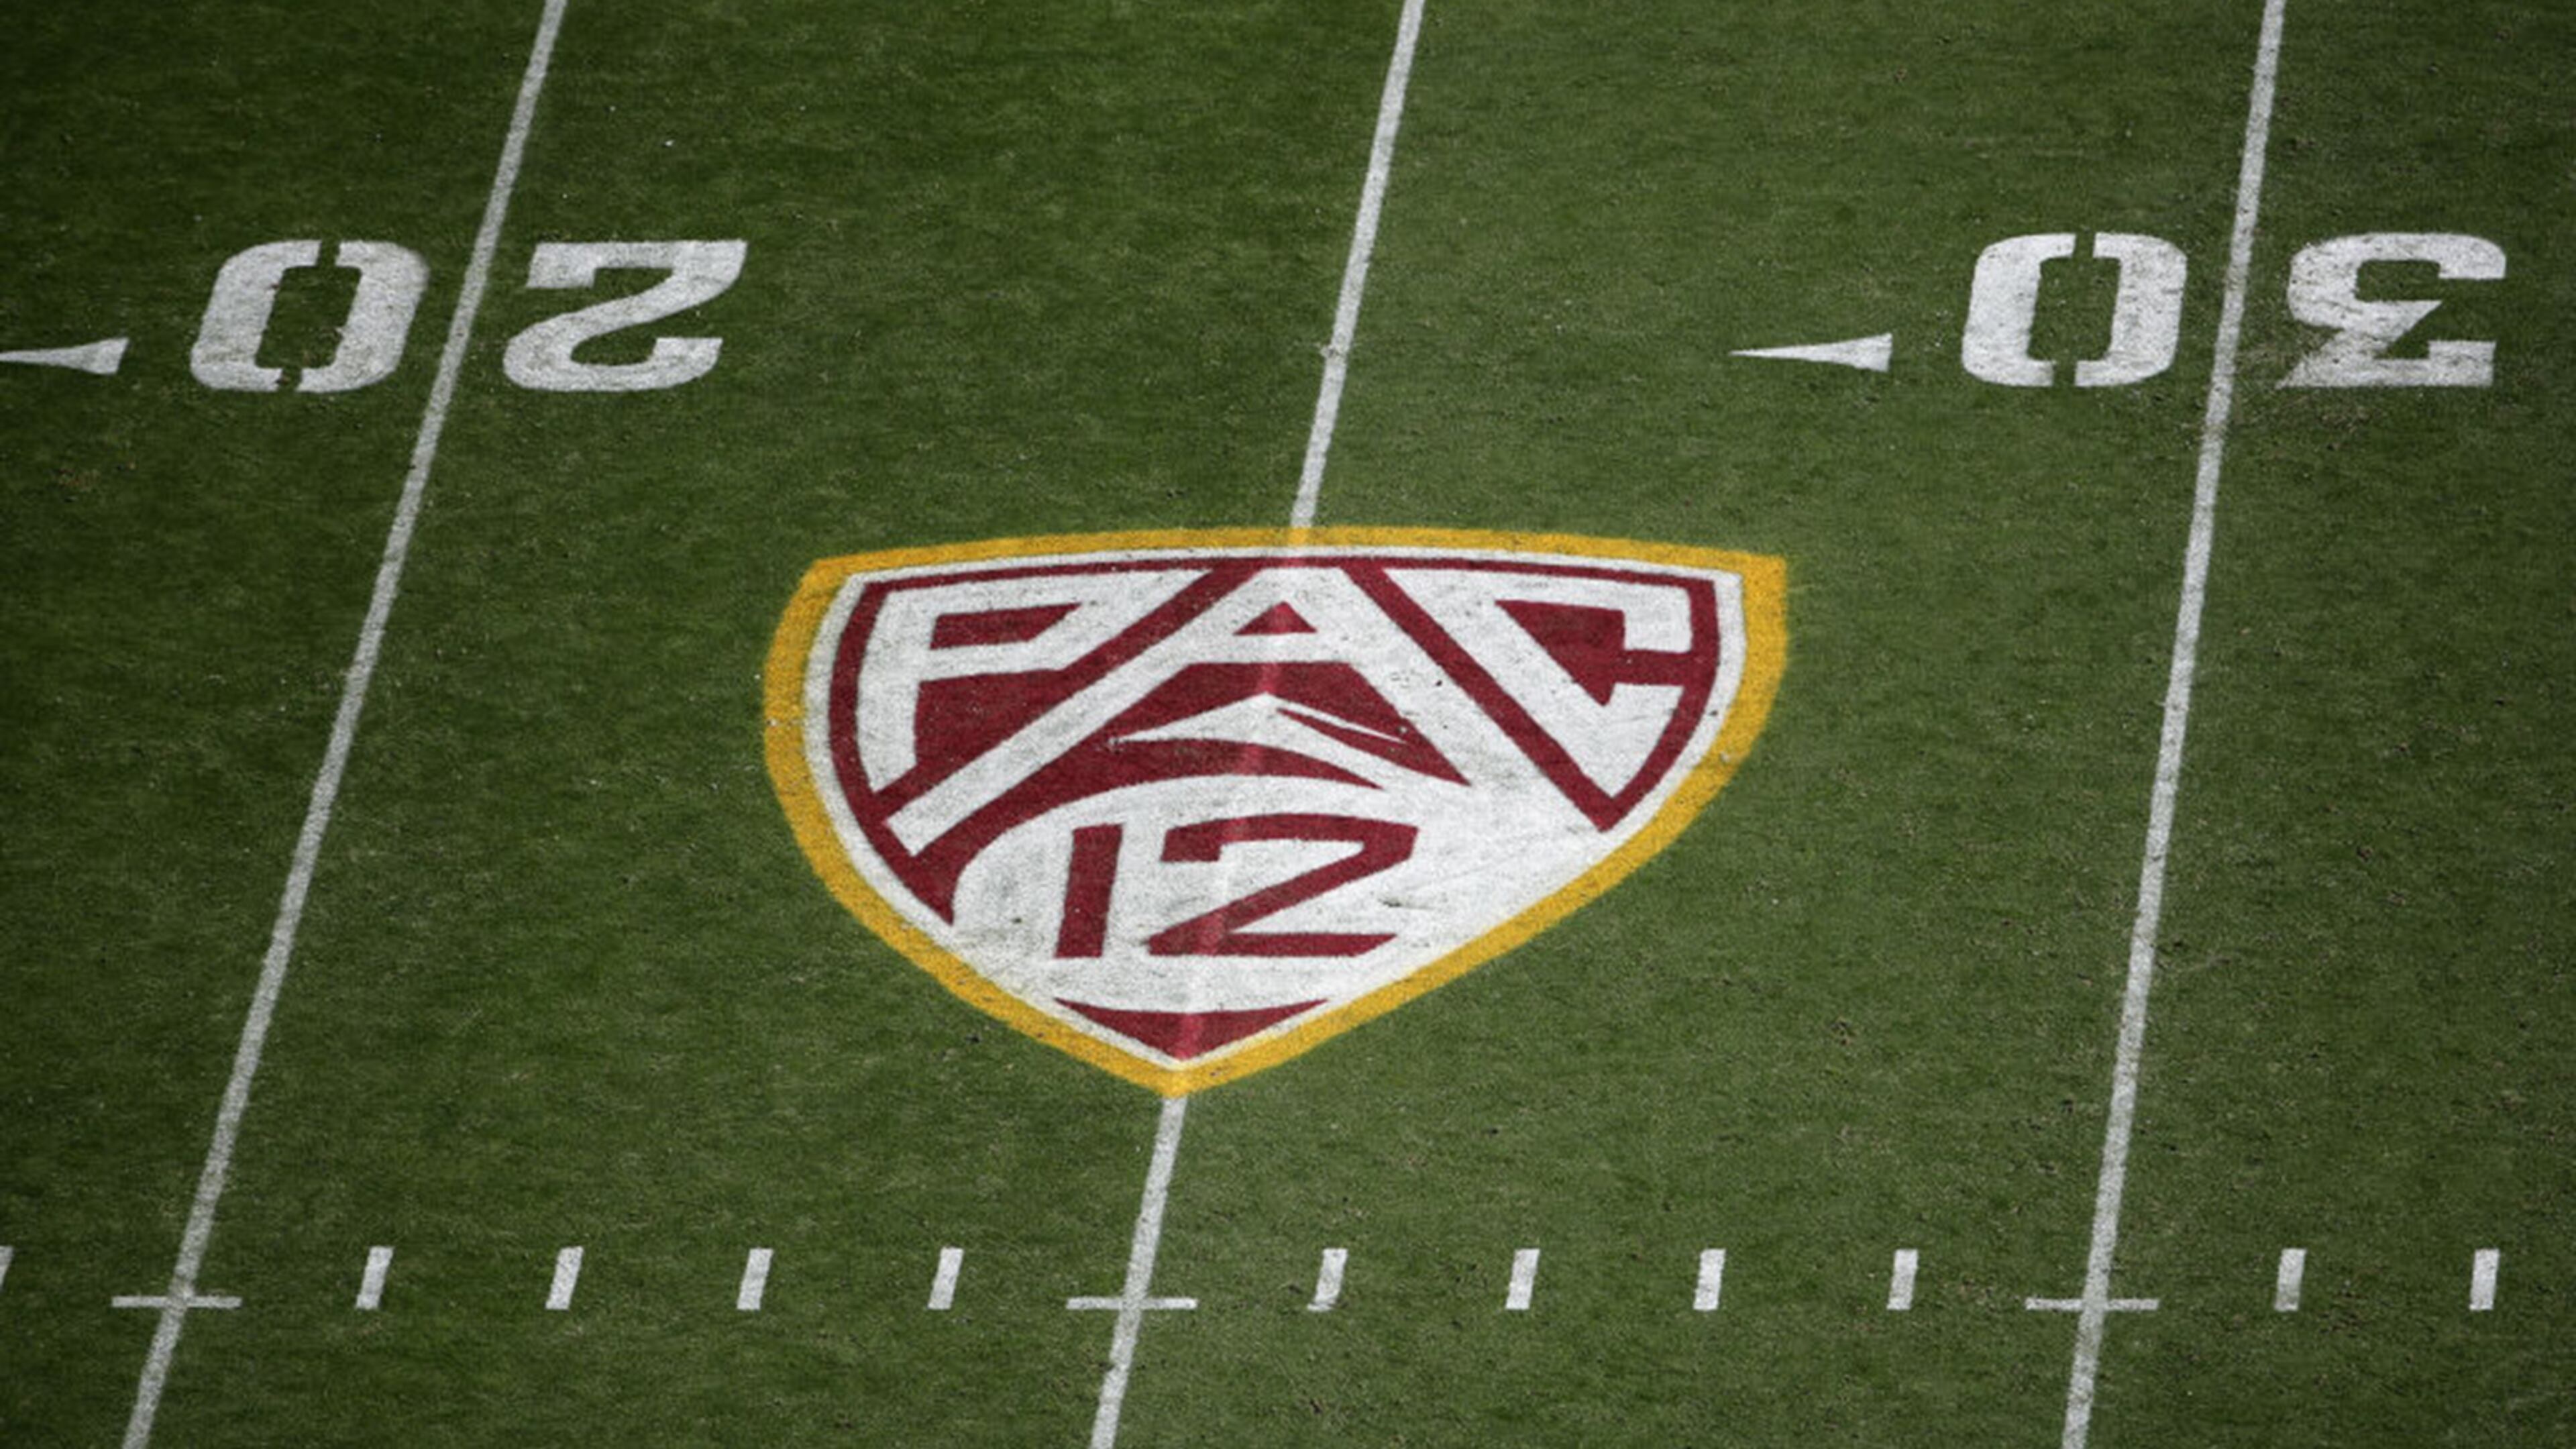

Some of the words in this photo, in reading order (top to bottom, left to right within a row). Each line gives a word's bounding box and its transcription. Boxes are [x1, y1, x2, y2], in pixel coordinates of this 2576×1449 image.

[191, 239, 748, 392] 20
[1961, 232, 2507, 388] 30
[857, 567, 1693, 857] PAC
[1055, 813, 1419, 959] 12
